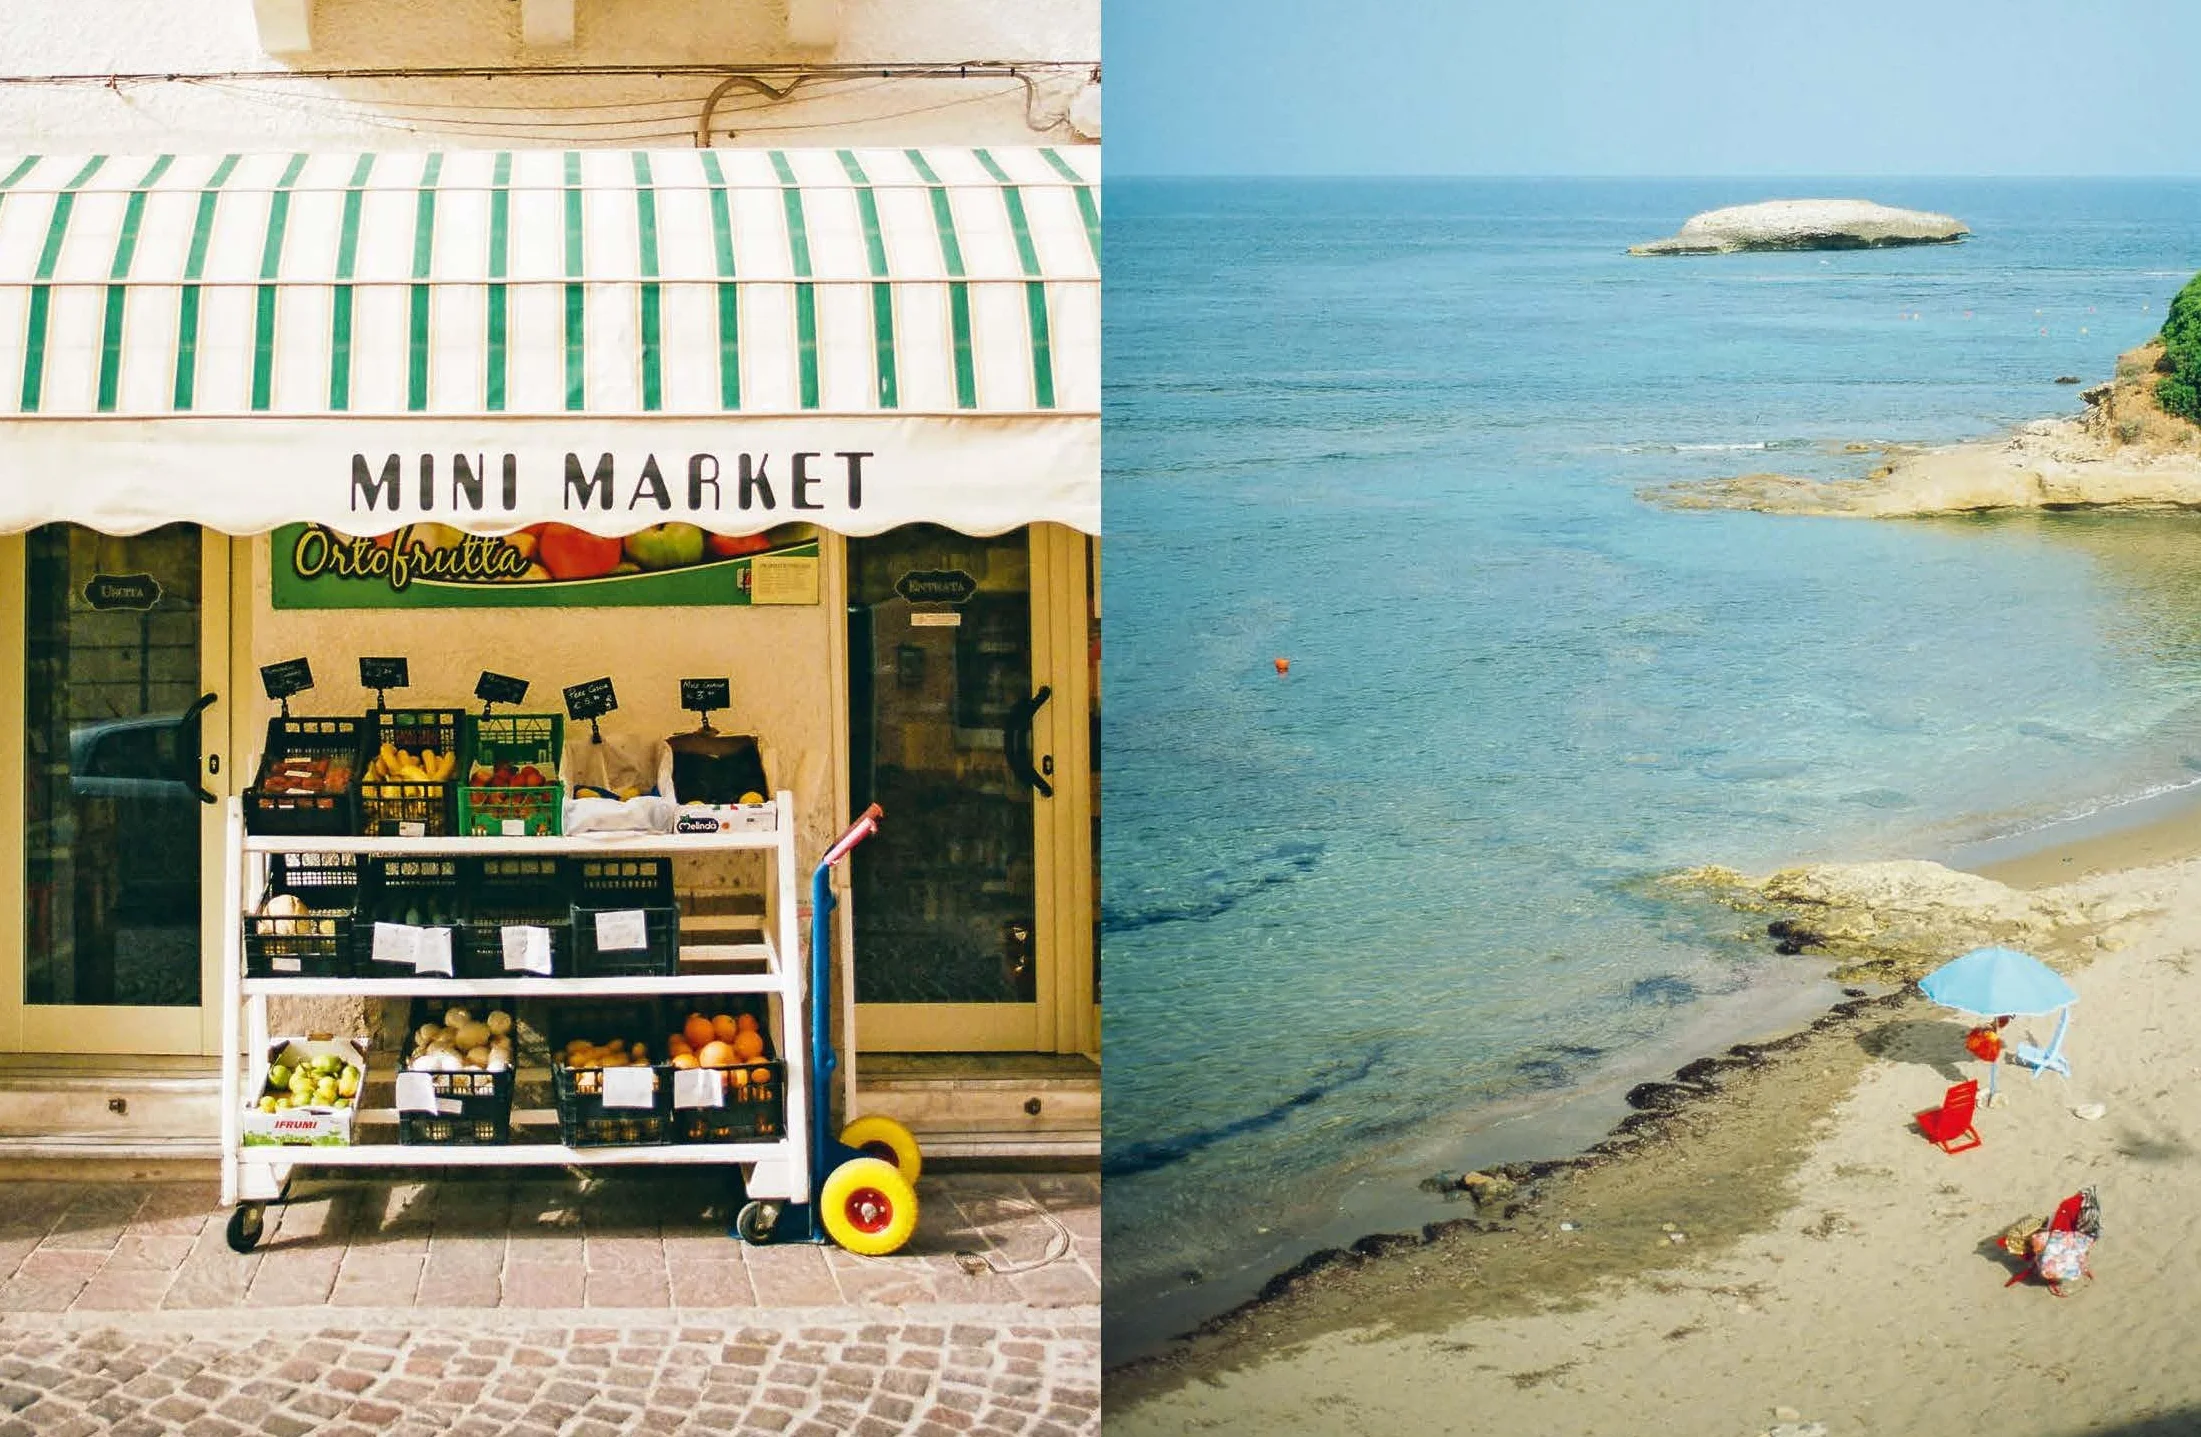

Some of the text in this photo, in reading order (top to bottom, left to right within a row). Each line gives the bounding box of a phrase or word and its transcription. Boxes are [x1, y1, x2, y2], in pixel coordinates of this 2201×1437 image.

[351, 451, 874, 512] MINI MARKET
[295, 524, 528, 588] Ortofrutta
[678, 821, 718, 831] Melinda
[274, 1120, 318, 1129] IFRUMI
